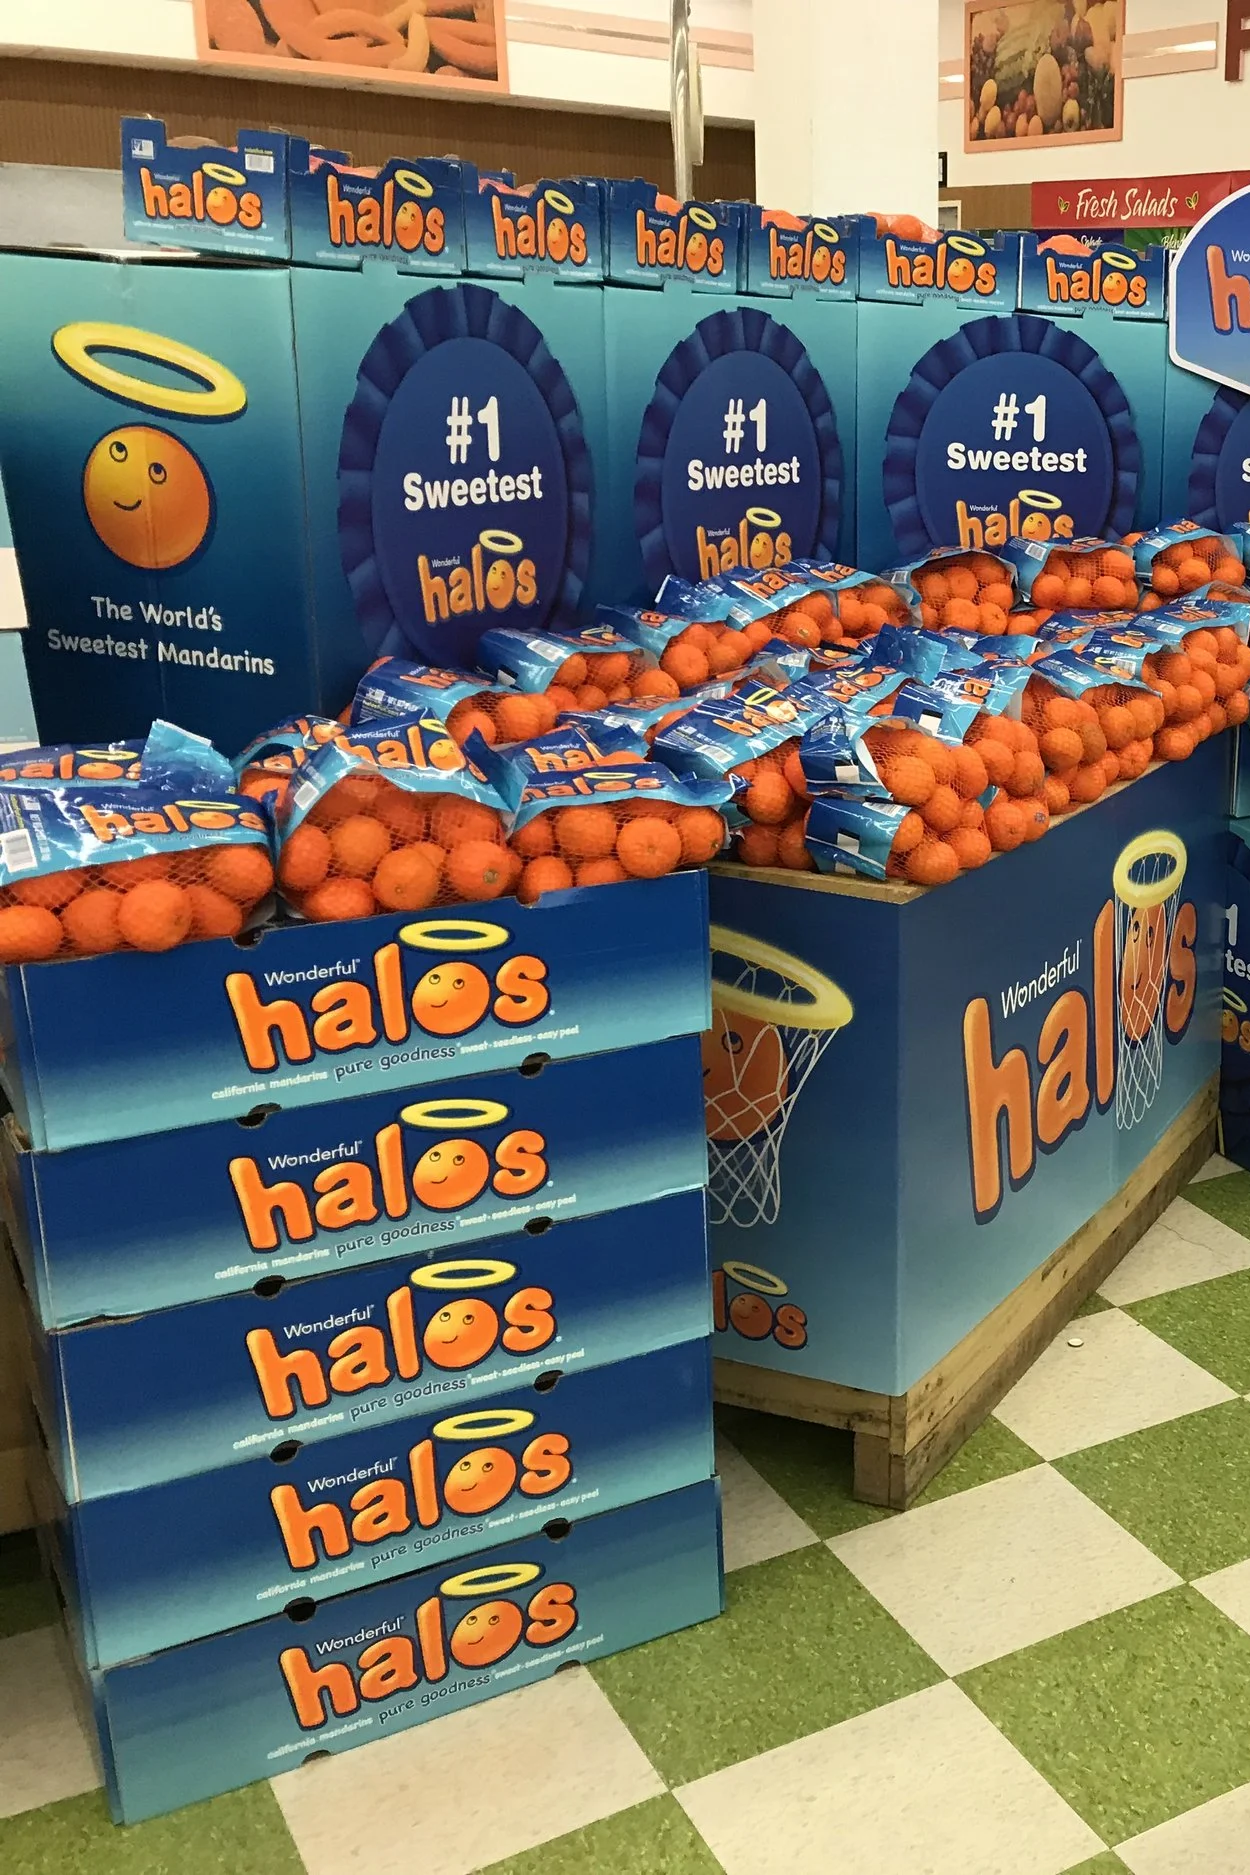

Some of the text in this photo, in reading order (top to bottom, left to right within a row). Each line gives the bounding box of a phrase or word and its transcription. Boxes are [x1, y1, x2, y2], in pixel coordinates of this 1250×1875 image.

[139, 167, 263, 229] halos
[327, 174, 446, 254] halos
[1076, 187, 1178, 220] Fresh Salads
[492, 195, 587, 265] halos
[636, 209, 724, 276] halos
[769, 227, 846, 285] halos
[886, 239, 997, 295] halos
[1046, 257, 1148, 306] halos
[446, 396, 500, 464] #1
[723, 398, 767, 454] #1
[991, 392, 1047, 442] #1
[687, 455, 801, 491] Sweetest
[946, 442, 1088, 473] Sweetest
[403, 465, 543, 511] Sweetest
[696, 518, 792, 581] halos
[417, 543, 538, 624] halos
[90, 596, 223, 632] The World's
[47, 629, 275, 676] Sweetest Mandarins
[525, 742, 604, 773] hal
[80, 804, 267, 843] halos
[265, 959, 357, 986] Wonderful
[1001, 939, 1081, 1019] Wonderful
[225, 943, 549, 1070] halos
[211, 1082, 266, 1100] california
[270, 1070, 328, 1090] mandarins
[335, 1060, 373, 1081] pure
[380, 1045, 456, 1070] goodness
[963, 898, 1197, 1213] halos
[268, 1142, 360, 1170] Wonderful
[228, 1123, 547, 1250] halos
[335, 1234, 374, 1257] pure
[380, 1218, 455, 1246] goodness
[283, 1305, 372, 1340] Wonderful
[712, 1269, 807, 1348] los
[246, 1286, 555, 1418] halos
[350, 1396, 388, 1422] pure
[393, 1376, 466, 1407] goodness
[270, 1434, 572, 1569] halos
[307, 1458, 394, 1494] Wonderful
[370, 1544, 408, 1570] pure
[413, 1521, 484, 1553] goodness
[279, 1583, 577, 1729] halos
[316, 1617, 402, 1656] Wonderful
[379, 1699, 415, 1725] pure
[420, 1673, 491, 1708] goodness
